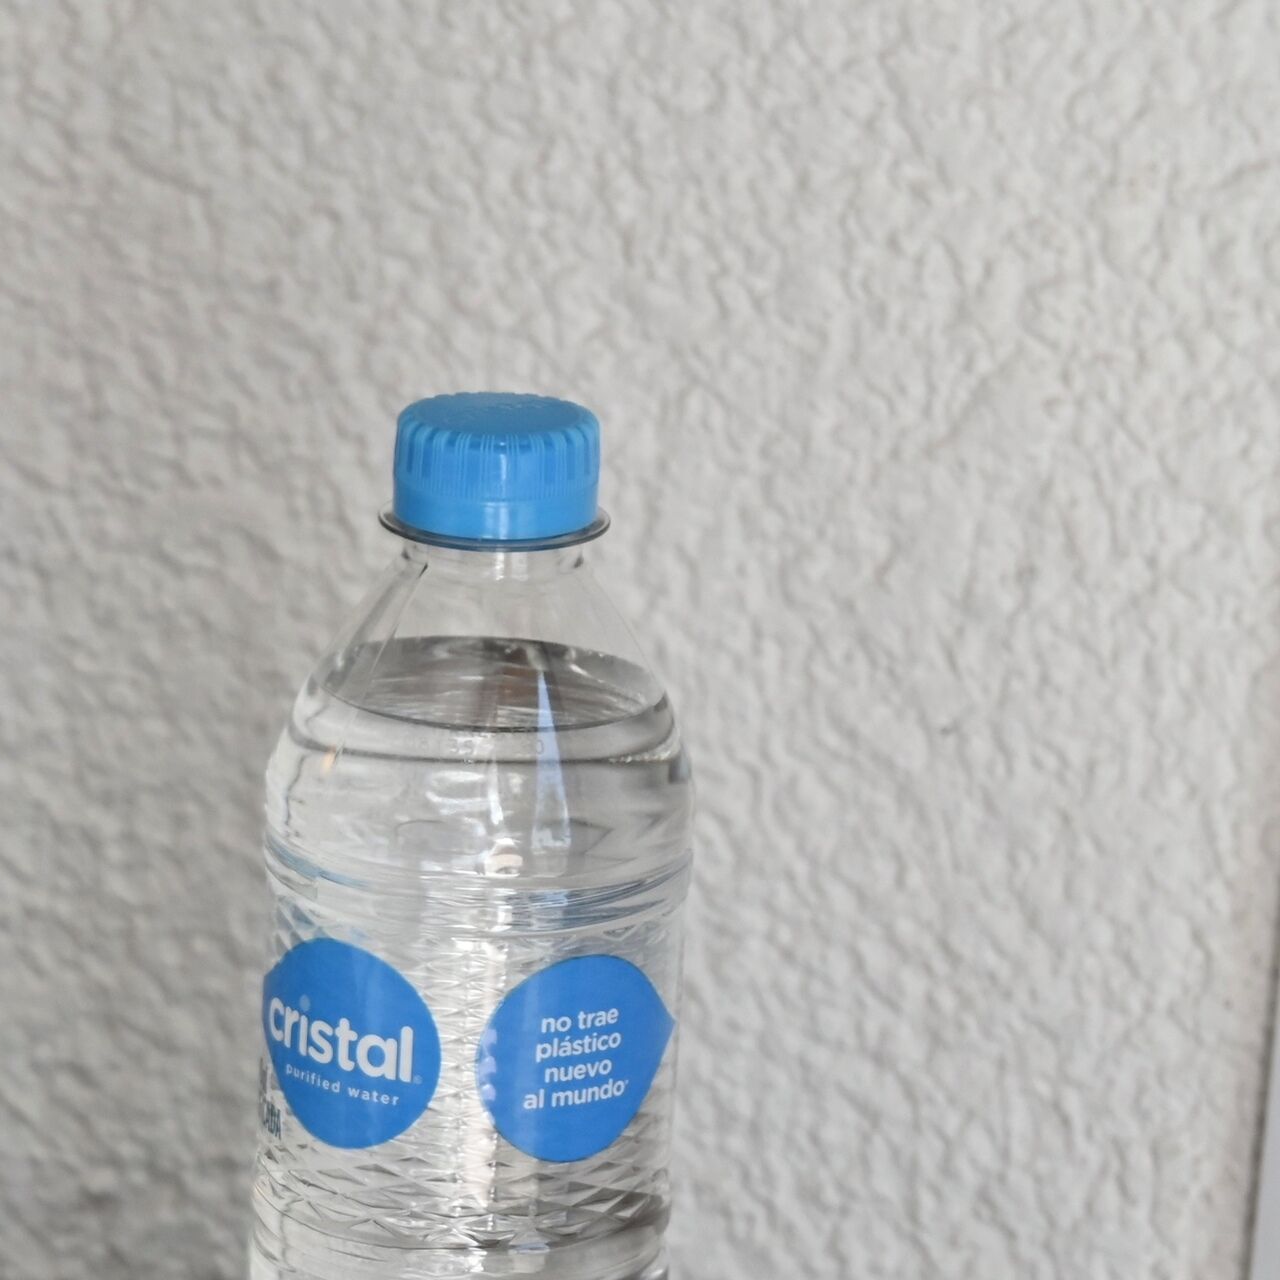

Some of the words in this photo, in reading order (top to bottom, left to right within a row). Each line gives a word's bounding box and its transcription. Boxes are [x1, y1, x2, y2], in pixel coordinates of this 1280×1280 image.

[541, 1016, 572, 1033] no
[578, 1008, 619, 1029] trae
[269, 995, 414, 1083] cristal
[536, 1032, 621, 1063] plástico
[286, 1064, 341, 1093] purified
[348, 1087, 399, 1106] water
[545, 1059, 612, 1083] nuevo
[523, 1089, 545, 1109] al
